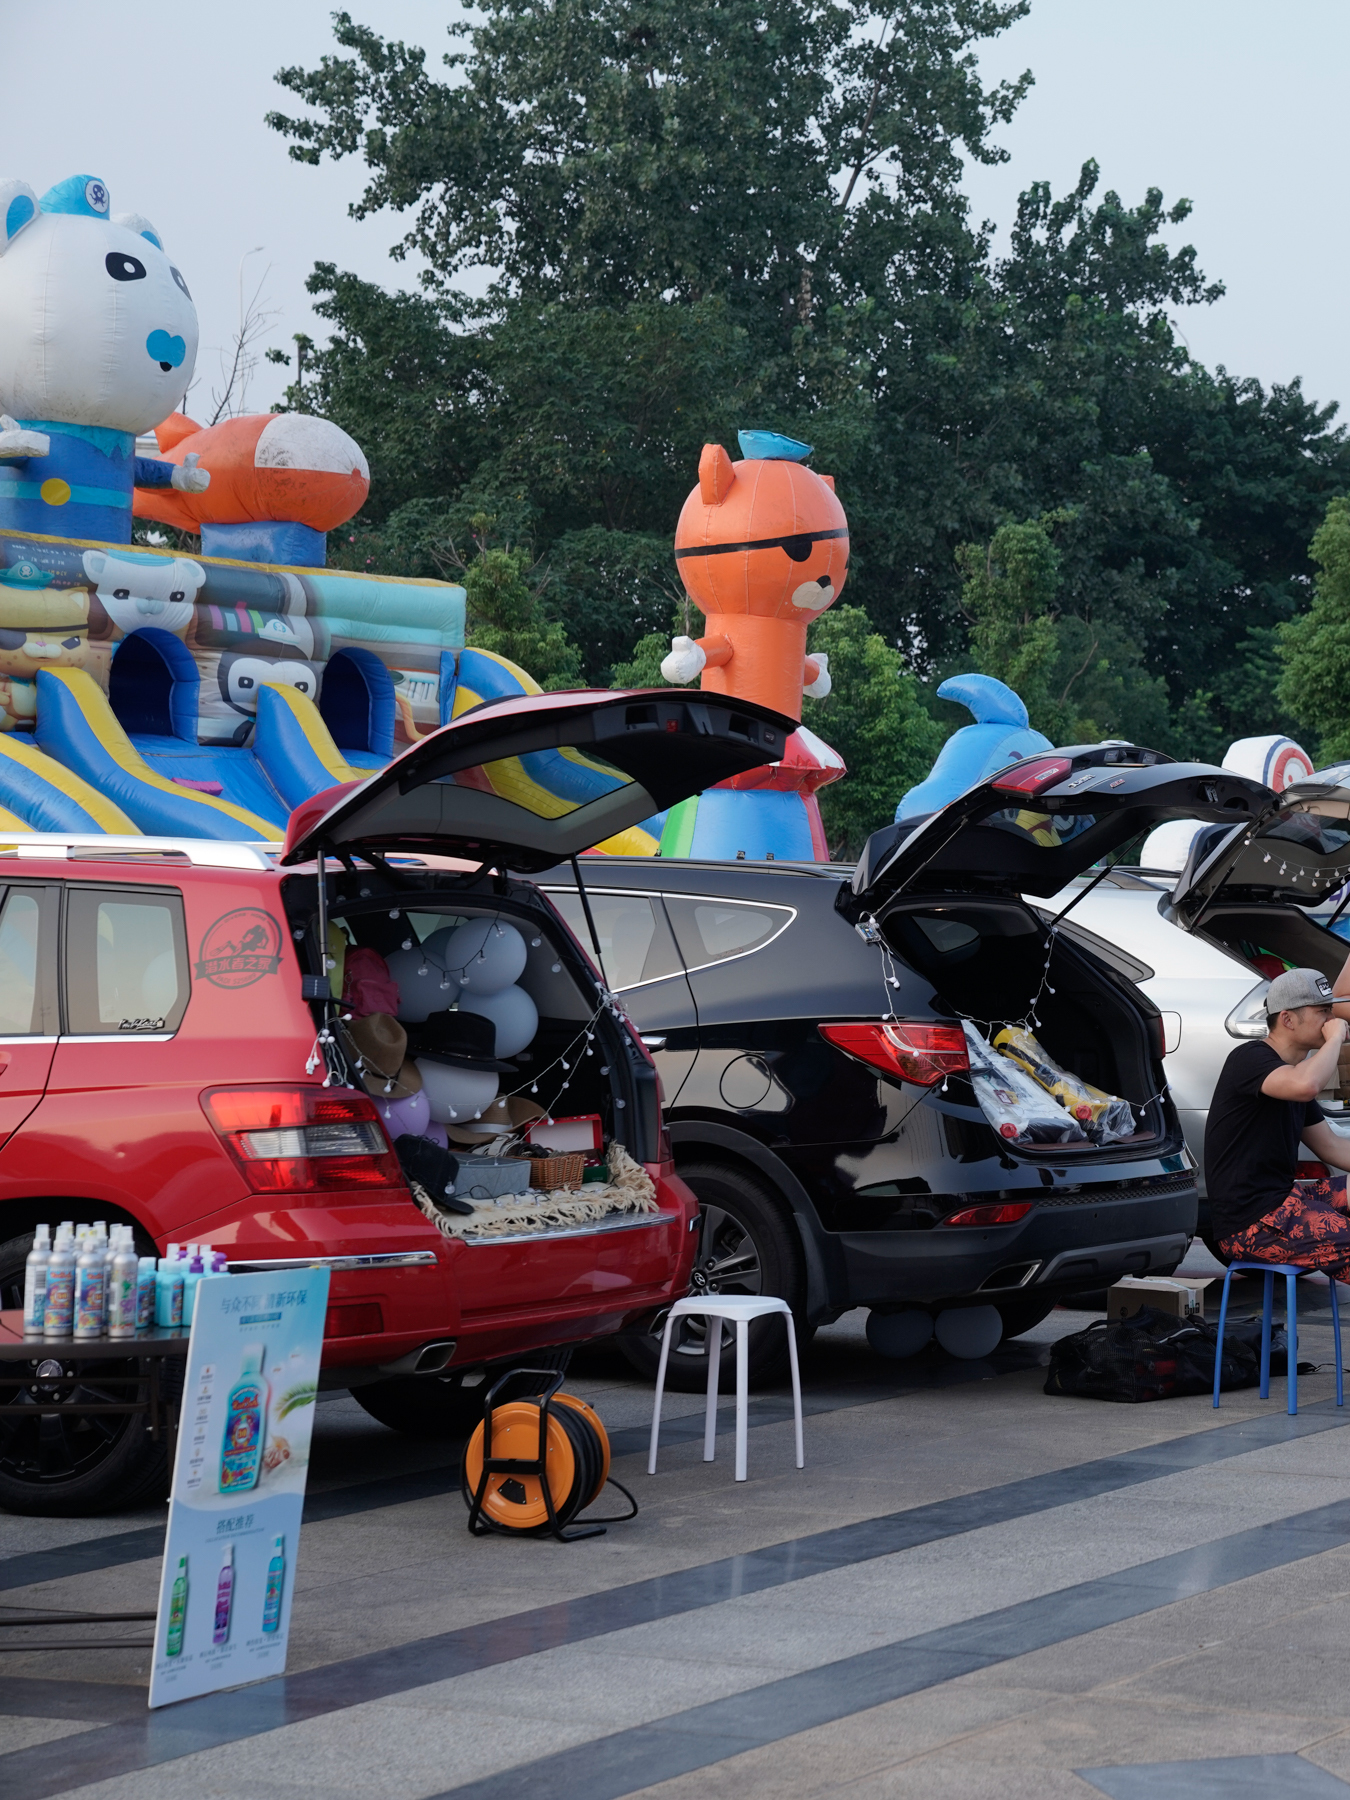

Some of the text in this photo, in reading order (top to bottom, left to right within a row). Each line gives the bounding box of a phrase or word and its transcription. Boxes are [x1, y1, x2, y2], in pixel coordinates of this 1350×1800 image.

[205, 957, 272, 975] 潜水者之家
